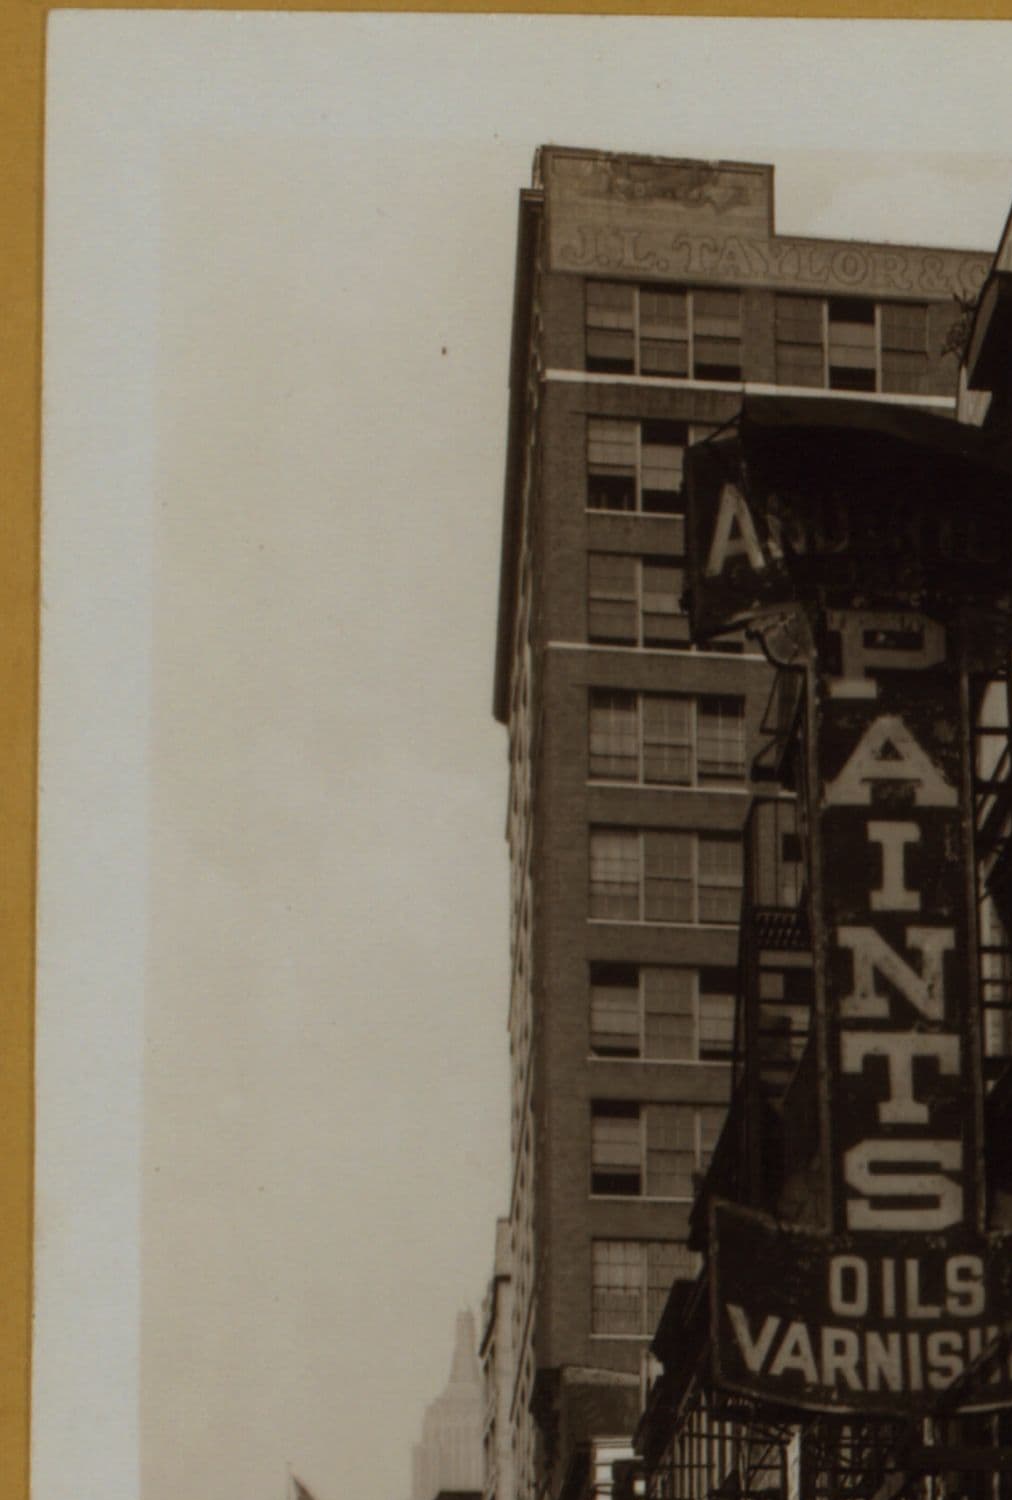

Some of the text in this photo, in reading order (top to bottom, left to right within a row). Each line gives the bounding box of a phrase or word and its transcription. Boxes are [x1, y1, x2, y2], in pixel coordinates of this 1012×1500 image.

[674, 235, 911, 290] TAYLOR
[918, 256, 951, 290] &
[823, 609, 963, 1231] PAINTS
[829, 1254, 985, 1319] OILS
